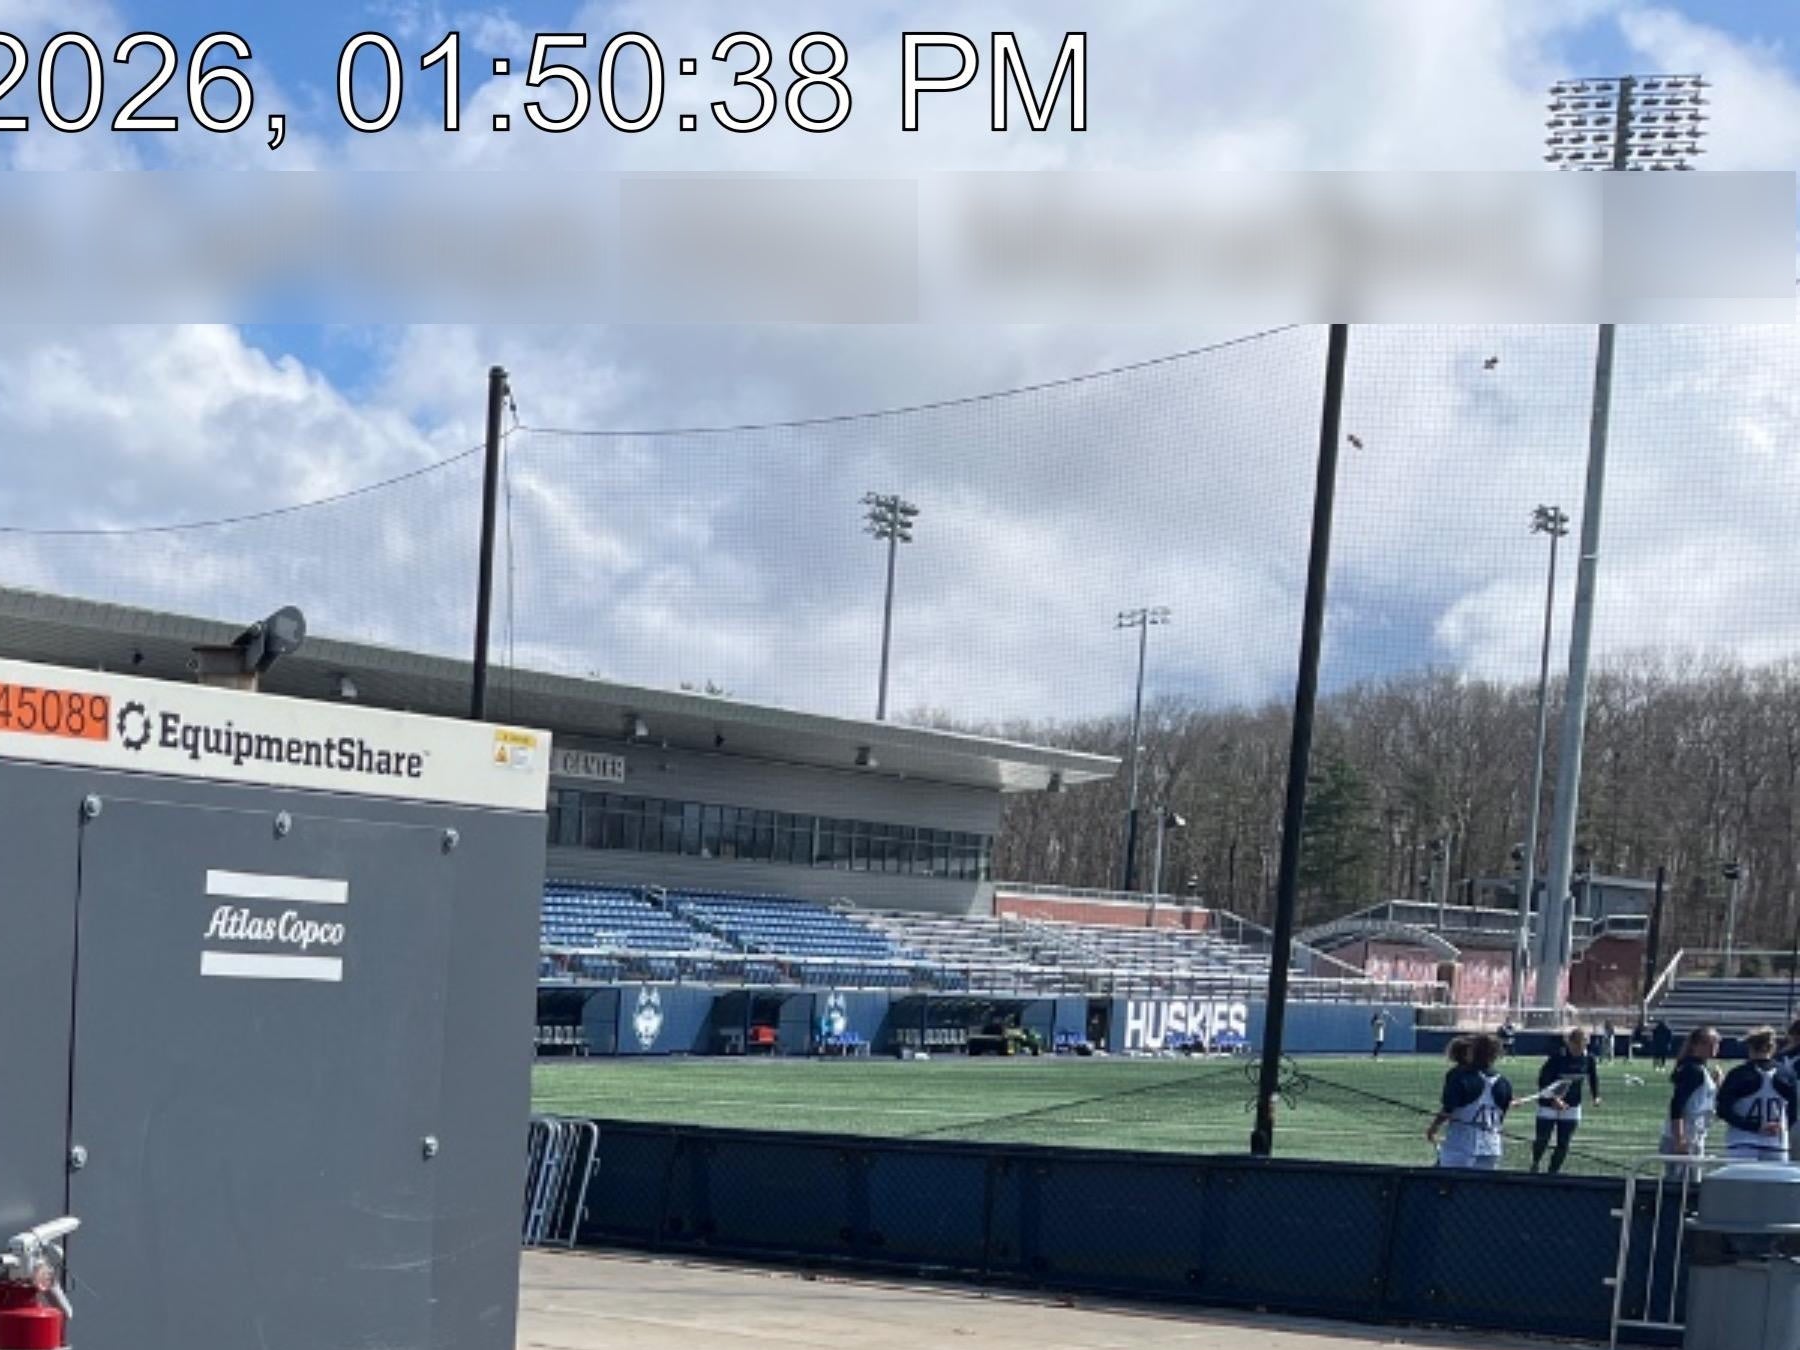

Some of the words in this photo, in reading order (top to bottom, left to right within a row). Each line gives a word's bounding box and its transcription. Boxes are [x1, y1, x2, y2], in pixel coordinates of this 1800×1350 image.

[159, 712, 422, 777] EquipmentShare
[203, 904, 277, 941] Atlas
[278, 909, 345, 950] Copco
[1124, 1000, 1248, 1050] HUSKIES
